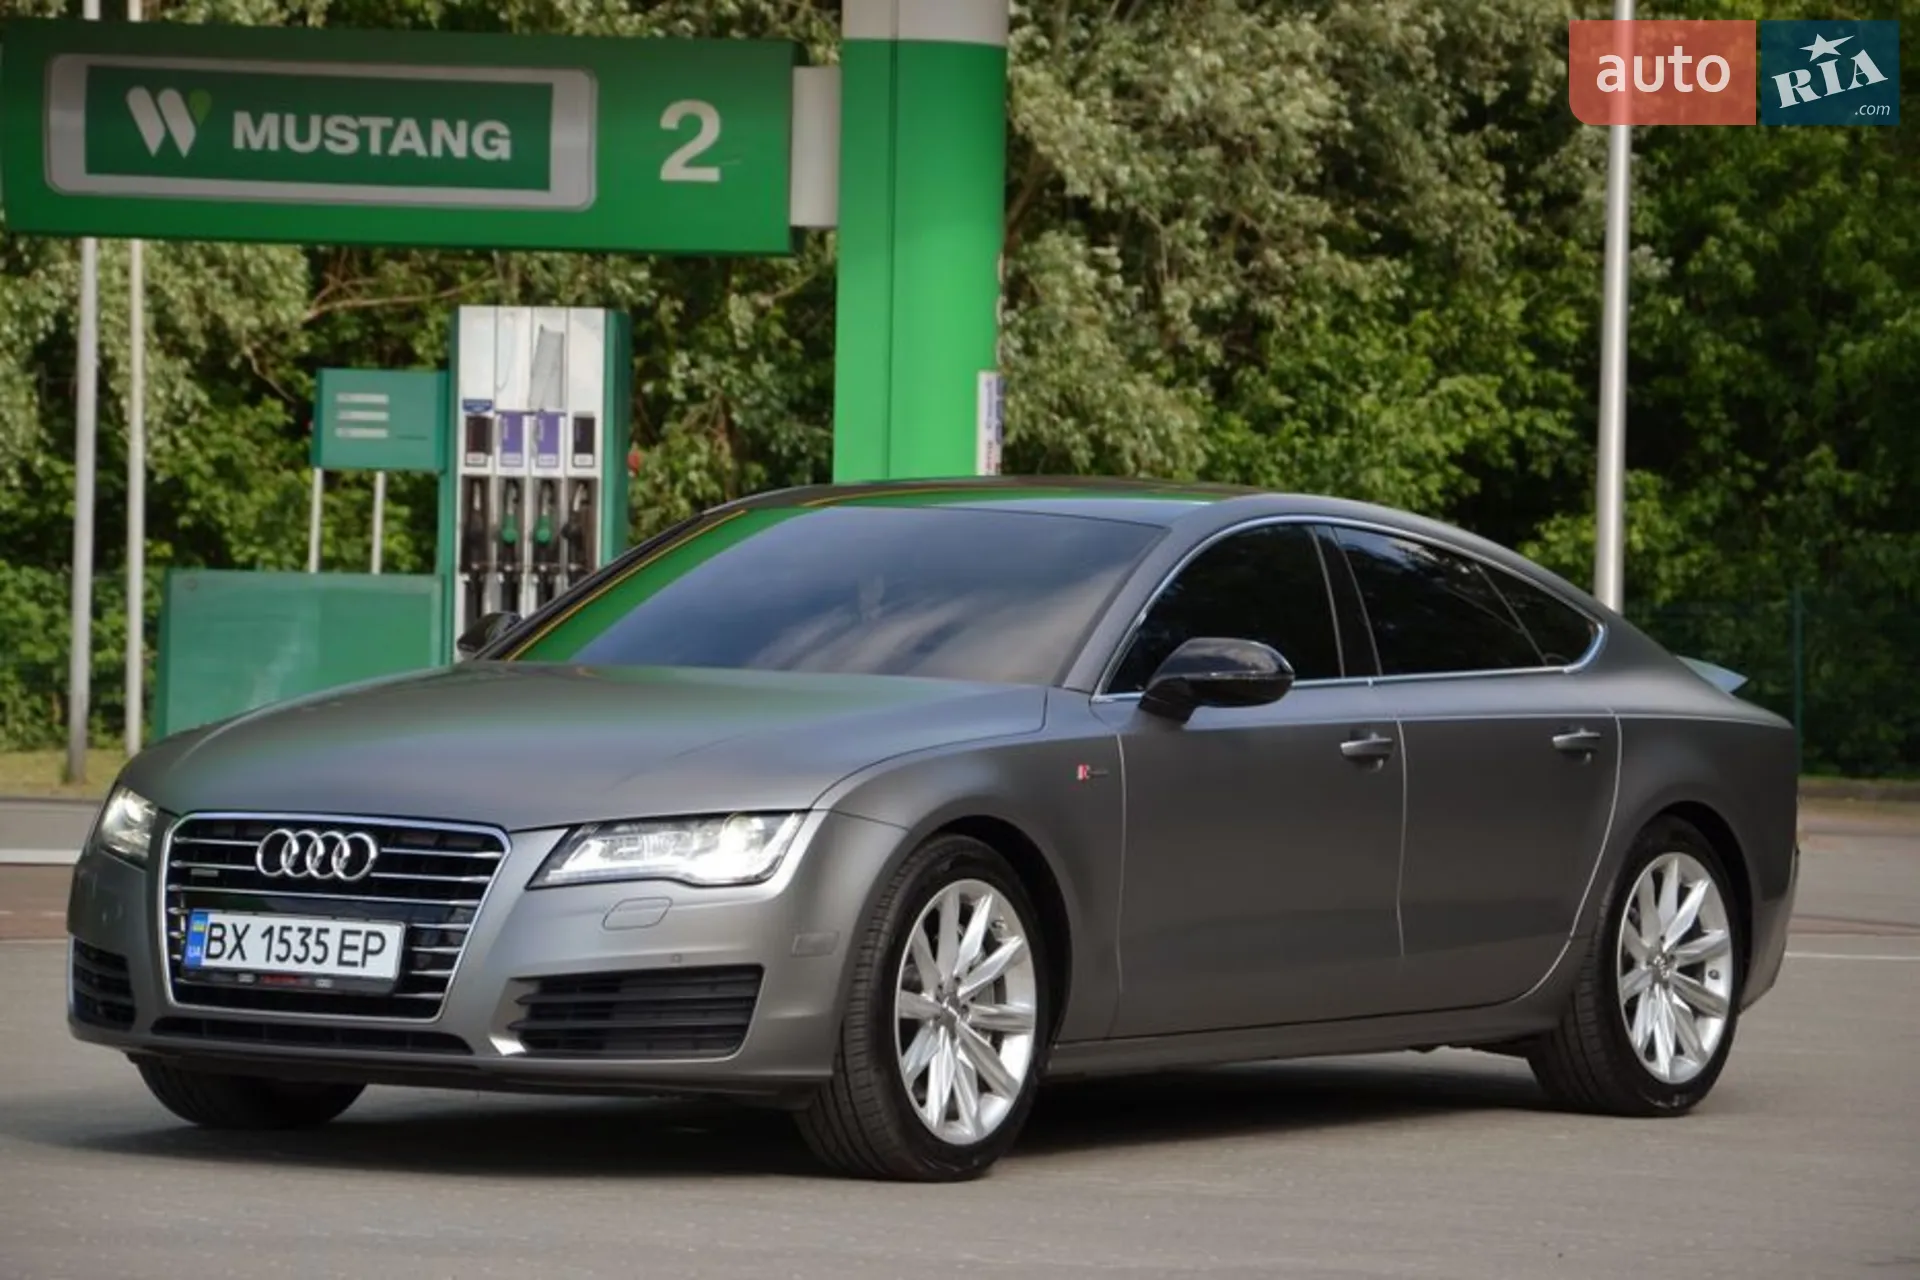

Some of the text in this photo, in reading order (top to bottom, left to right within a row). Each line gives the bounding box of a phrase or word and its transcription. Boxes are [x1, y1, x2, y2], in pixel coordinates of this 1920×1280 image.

[233, 111, 512, 160] MUSTANG
[660, 99, 720, 181] 2
[206, 923, 386, 968] BX 1535 EP
